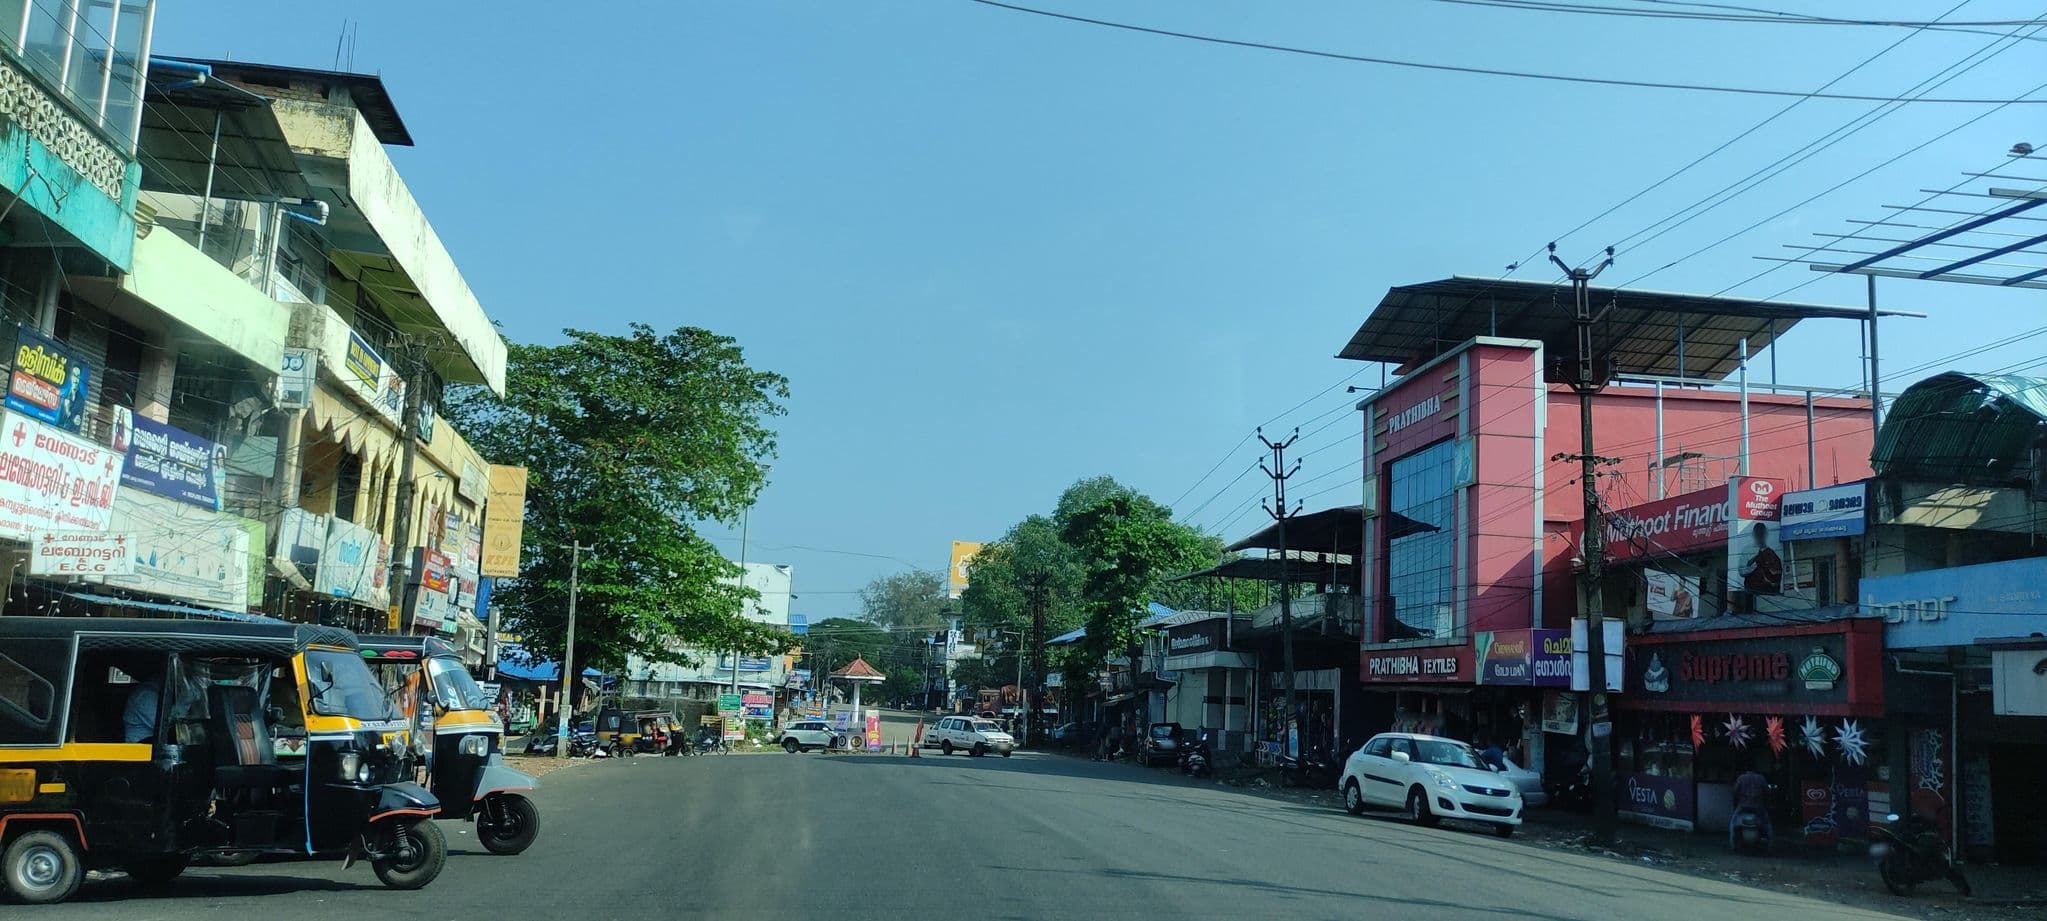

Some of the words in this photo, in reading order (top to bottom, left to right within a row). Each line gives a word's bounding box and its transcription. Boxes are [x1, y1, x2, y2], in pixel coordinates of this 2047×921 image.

[1389, 394, 1441, 434] PRATHIBHA
[34, 432, 99, 465] വേണാട്
[1745, 501, 1777, 510] Muthoot
[1754, 494, 1769, 502] The
[1673, 500, 1729, 530] Financ
[1750, 508, 1773, 518] Group
[1868, 592, 1956, 623] honor
[1369, 656, 1419, 675] PRATHIBHA
[1423, 658, 1457, 674] TEXTILES
[1681, 651, 1789, 684] Supreme
[1628, 776, 1658, 805] VESTA
